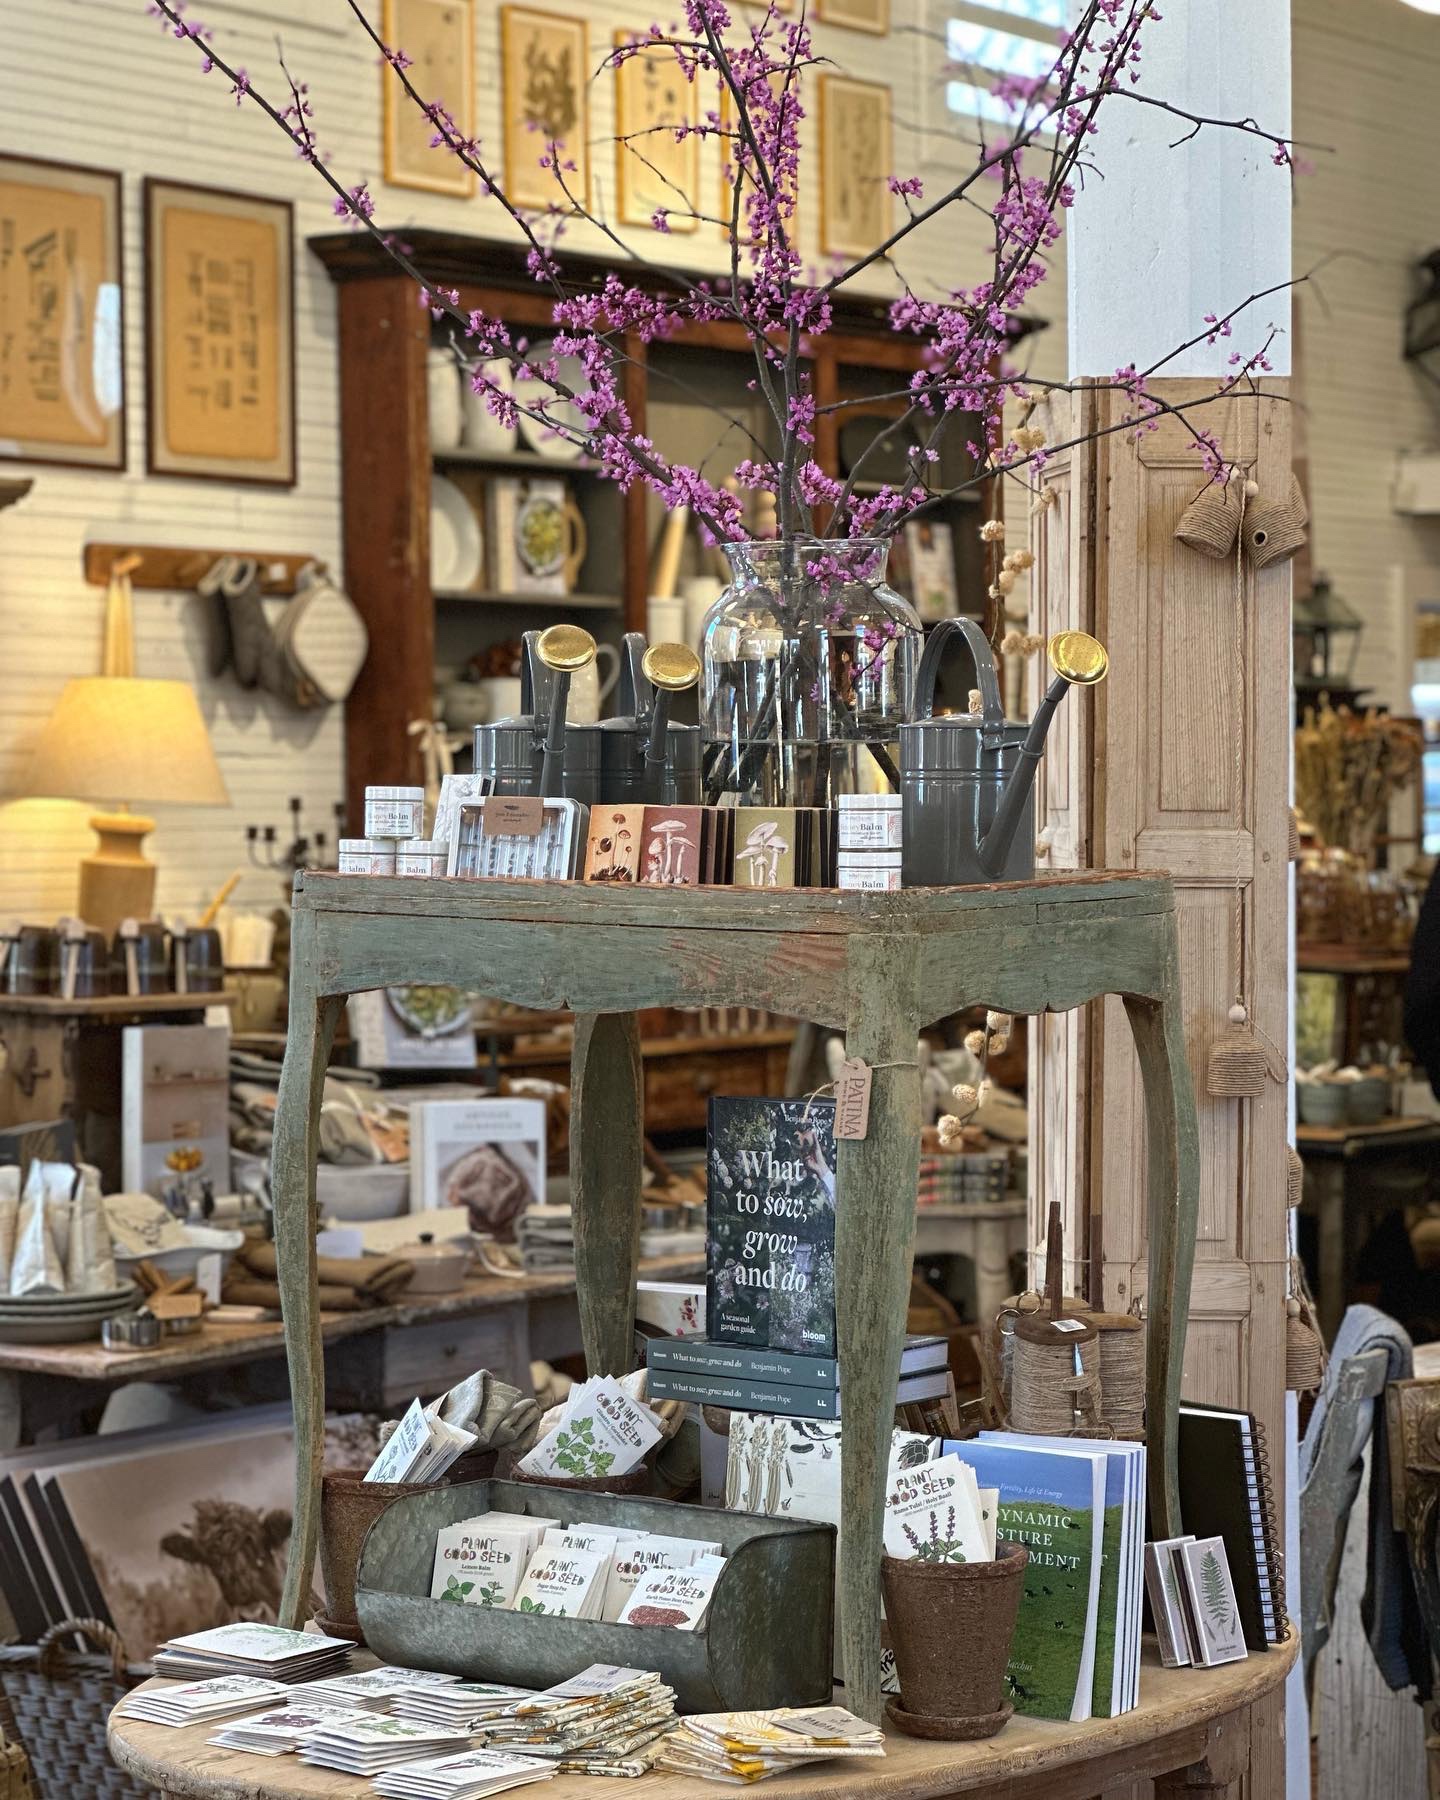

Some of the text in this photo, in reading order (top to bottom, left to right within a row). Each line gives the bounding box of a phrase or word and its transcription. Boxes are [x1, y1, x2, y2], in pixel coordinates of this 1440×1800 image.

[843, 1077, 866, 1137] PATINA
[741, 1151, 804, 1182] What
[736, 1190, 807, 1223] to sow,
[743, 1230, 798, 1259] grow
[735, 1262, 807, 1292] and do
[726, 1314, 750, 1324] seasonal
[720, 1323, 756, 1335] garden guide
[802, 1329, 826, 1341] bloom
[672, 1352, 688, 1361] What
[722, 1359, 734, 1367] and
[734, 1360, 742, 1368] do
[751, 1362, 792, 1375] Benjamin Pope
[672, 1383, 688, 1391] What
[722, 1389, 734, 1397] and
[734, 1390, 742, 1398] do
[750, 1392, 792, 1405] Benjamin Pope
[613, 1396, 643, 1426] PLANT
[596, 1393, 621, 1420] GOOD
[620, 1421, 642, 1447] SEED
[896, 1467, 935, 1492] PLANT
[884, 1476, 956, 1508] GOOD SEED
[1024, 1486, 1036, 1495] Life
[1044, 1489, 1063, 1499] Energy
[893, 1507, 909, 1515] Rama
[909, 1501, 922, 1509] Tulsi
[938, 1491, 952, 1500] Basil
[997, 1508, 1072, 1529] YNAMIC
[461, 1536, 499, 1550] PLANT
[561, 1535, 596, 1551] PLANT
[997, 1527, 1053, 1546] STURE
[444, 1548, 512, 1564] GOOD SEED
[633, 1550, 669, 1565] PLANT
[1028, 1550, 1081, 1569] MENT
[546, 1559, 579, 1573] PLANT
[616, 1562, 648, 1575] GOOD
[529, 1569, 585, 1586] GOOD SEED
[663, 1575, 701, 1588] PLANT
[645, 1584, 706, 1599] GOOD SEED
